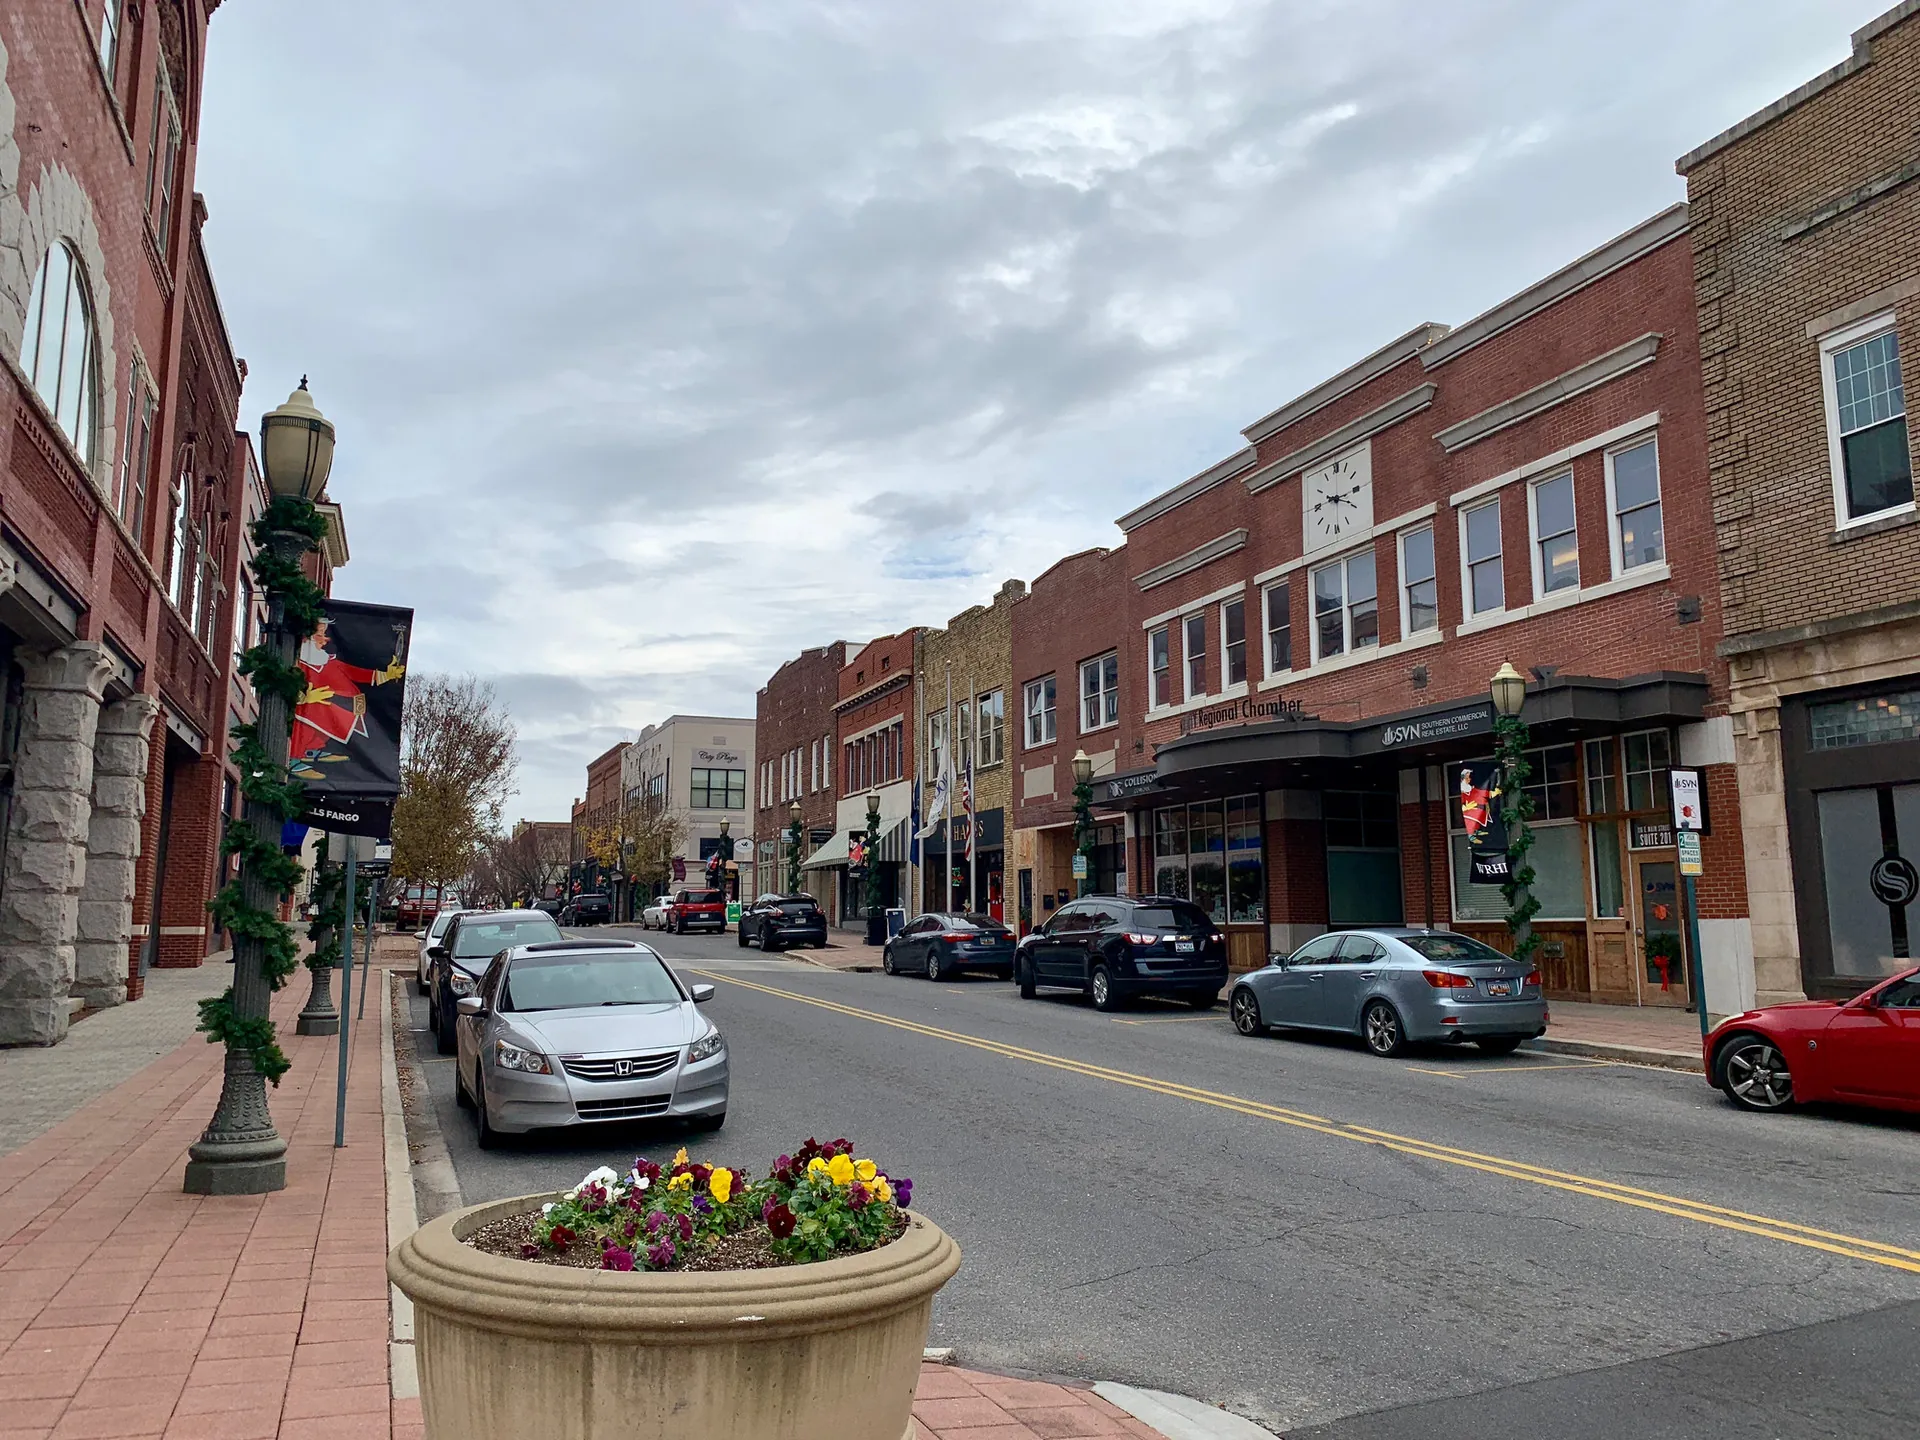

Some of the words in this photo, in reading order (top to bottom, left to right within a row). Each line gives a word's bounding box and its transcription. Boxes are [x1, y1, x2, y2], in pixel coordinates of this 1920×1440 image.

[1199, 701, 1237, 728] Regional
[1242, 695, 1302, 717] Chamber
[1421, 718, 1451, 729] SOUTHERN
[1452, 711, 1488, 723] COMMERCIAL
[1396, 724, 1420, 742] SVN
[1421, 730, 1435, 738] REAL
[1458, 723, 1469, 731] LLC
[1682, 779, 1697, 788] SVN
[327, 810, 359, 821] FARGO
[1640, 832, 1658, 846] SUITE
[1660, 832, 1672, 844] 201
[1679, 835, 1685, 846] 2
[1476, 862, 1508, 874] WRHI
